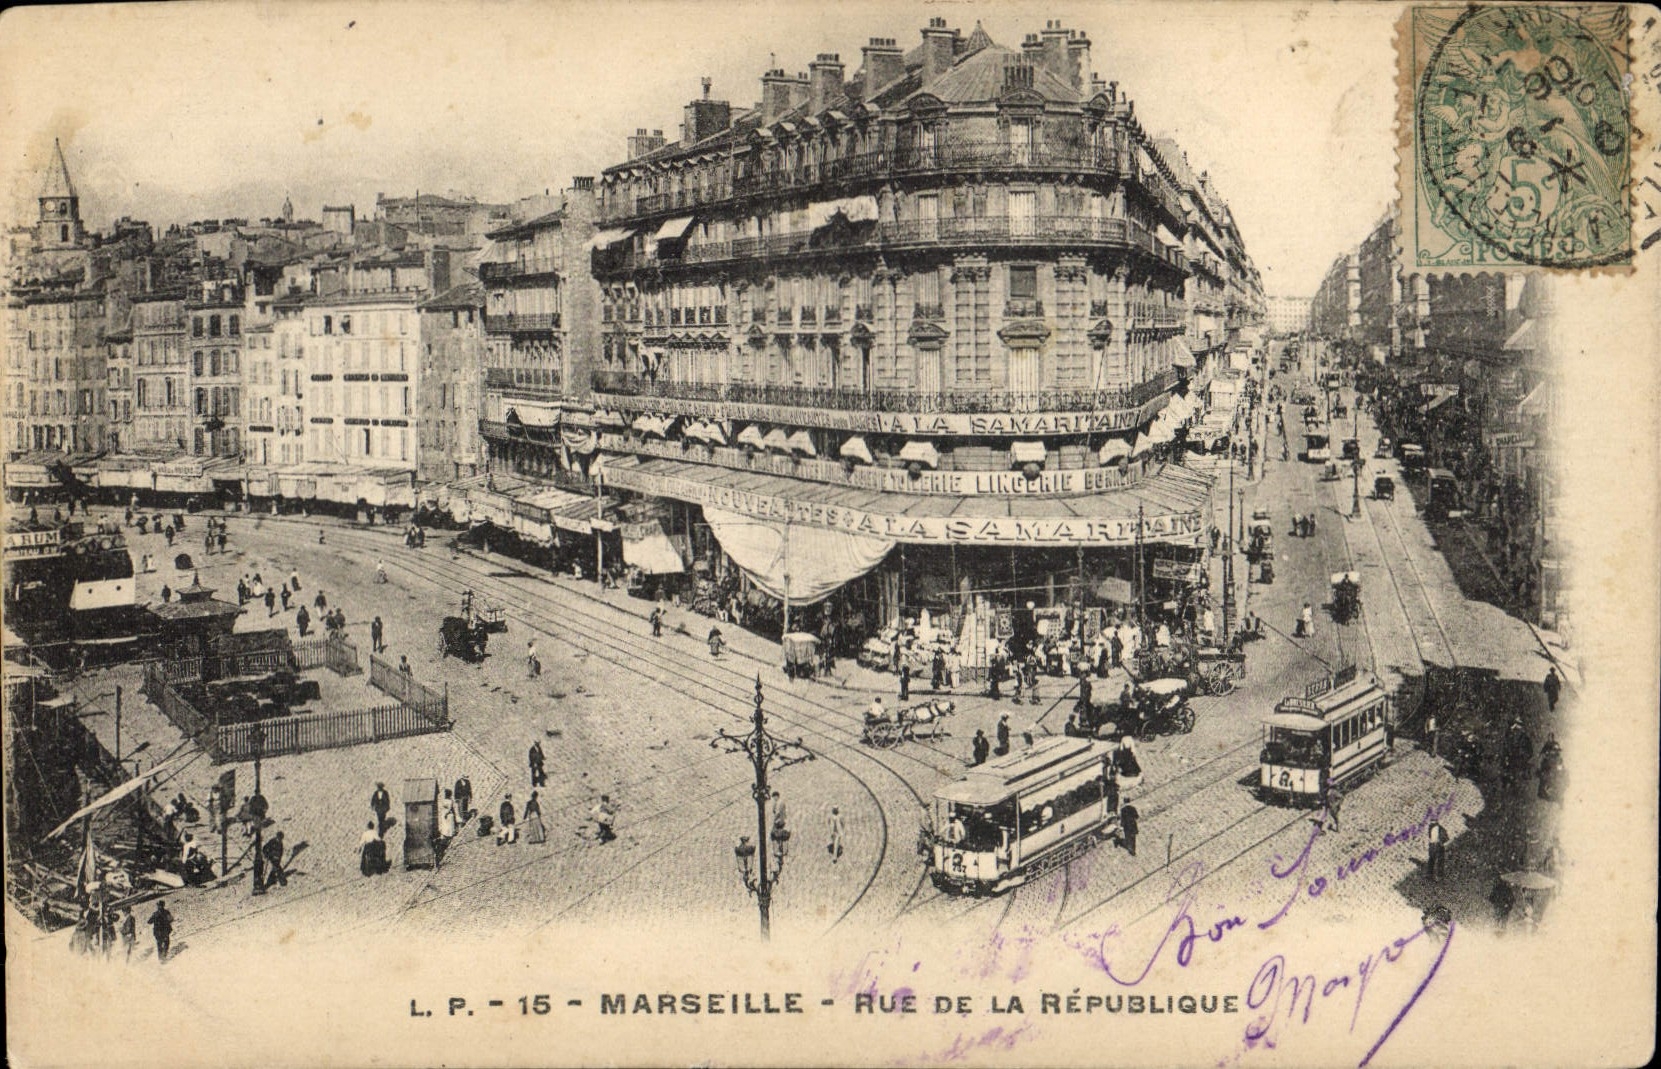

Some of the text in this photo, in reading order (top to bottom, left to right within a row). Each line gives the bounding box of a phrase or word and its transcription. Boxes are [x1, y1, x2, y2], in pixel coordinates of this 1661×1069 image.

[1475, 240, 1570, 263] POSTES
[890, 416, 908, 434] A
[913, 416, 958, 435] LA
[976, 471, 1073, 494] LINGERIE
[857, 513, 880, 534] A
[884, 516, 939, 539] LA
[946, 514, 1203, 541] SAMARITAINE
